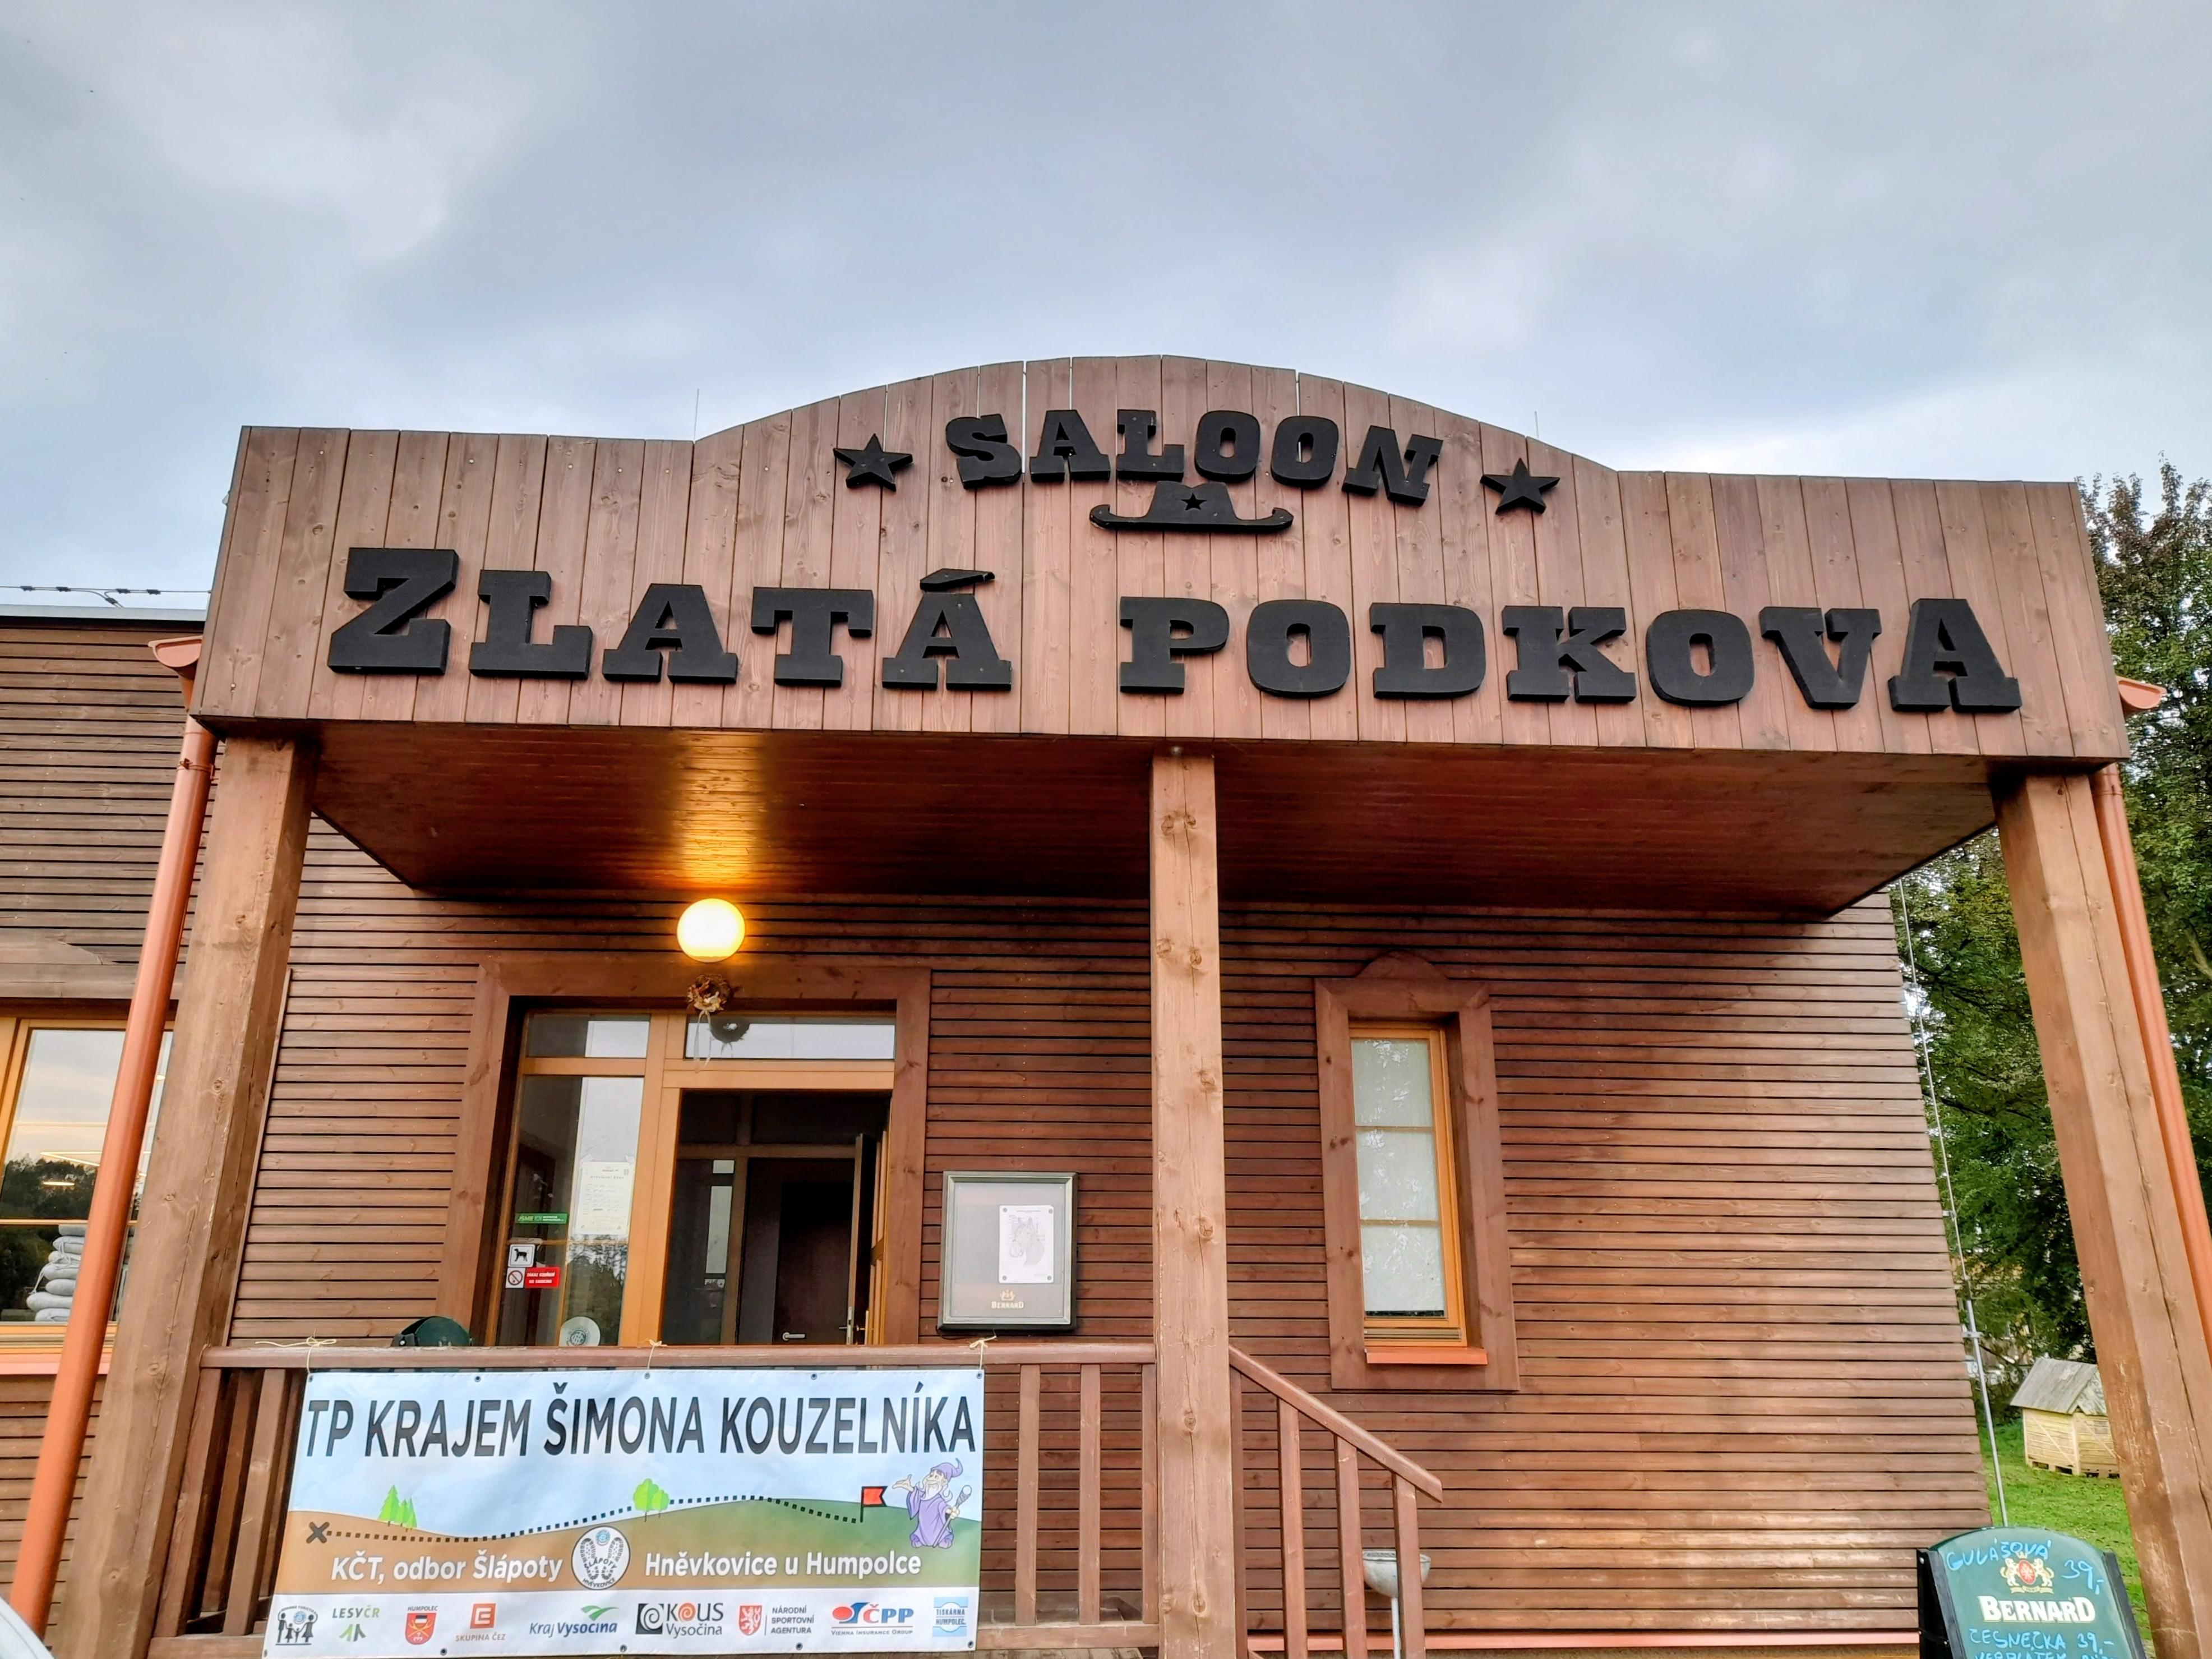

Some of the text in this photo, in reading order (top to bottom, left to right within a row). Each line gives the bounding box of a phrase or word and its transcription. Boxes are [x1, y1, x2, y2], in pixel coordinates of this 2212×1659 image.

[946, 409, 1444, 506] SALOON
[327, 547, 2022, 713] ZLATÁ PODKOVA
[991, 1301, 1024, 1309] BERNARD
[306, 1381, 976, 1457] TP KRAJEM ŠIMONA KOUZELNÍKA
[330, 1549, 563, 1585] KČT, odbor Šlápoty
[644, 1550, 922, 1580] Hněvkovice u Humpolce
[666, 1602, 724, 1623] KOUS
[771, 1614, 815, 1624] SPORTOVNÍ
[772, 1605, 807, 1614] NÁRODNÍ
[862, 1603, 915, 1623] ČPP
[1977, 1596, 2096, 1624] BERNARD
[492, 1632, 506, 1641] ČEZ
[529, 1622, 554, 1638] Kraj
[666, 1623, 723, 1639] Vysočina
